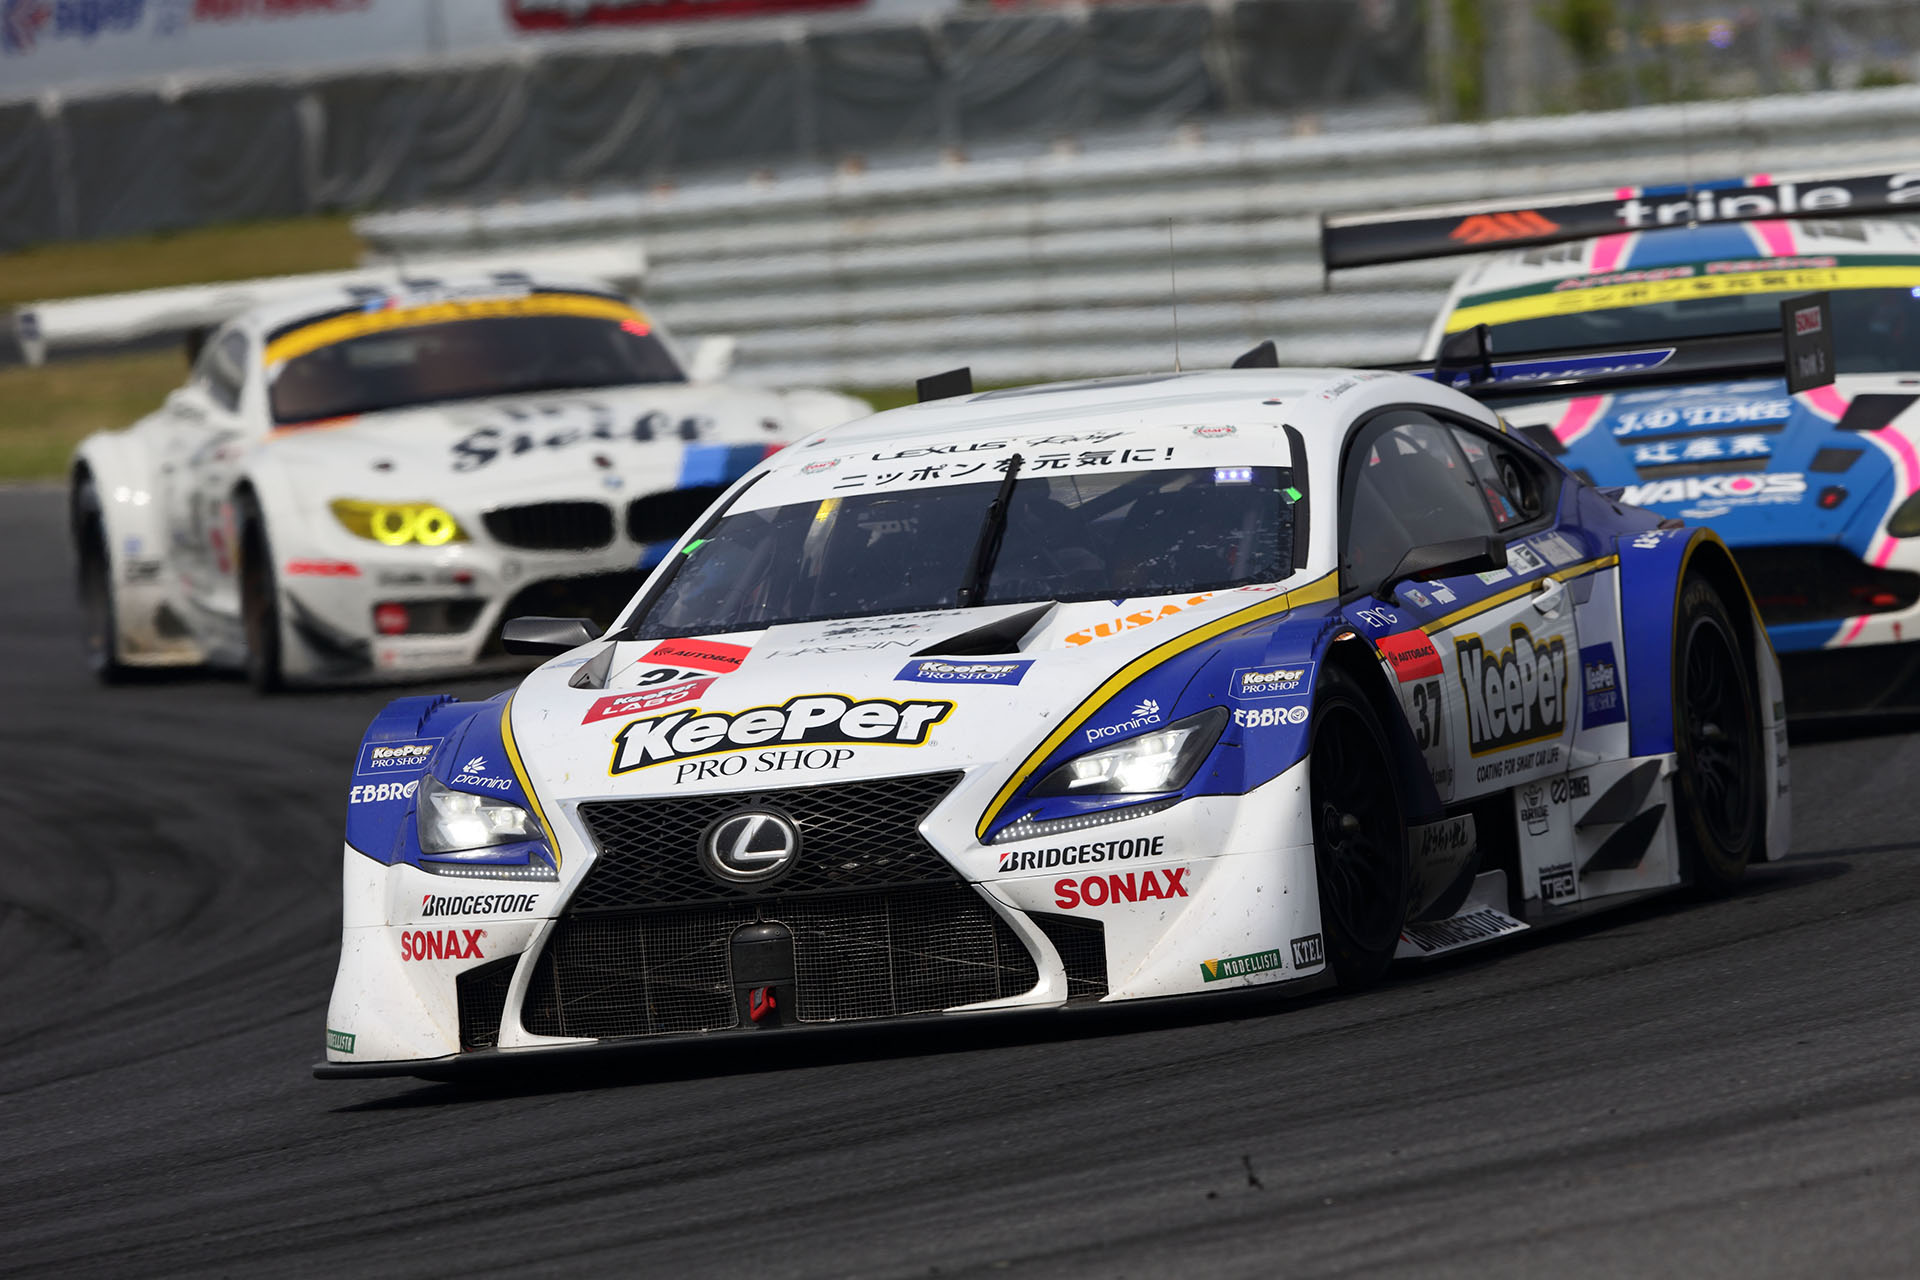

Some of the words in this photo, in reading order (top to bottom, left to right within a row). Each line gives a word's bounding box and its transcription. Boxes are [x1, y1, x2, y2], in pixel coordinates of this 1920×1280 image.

[1615, 182, 1851, 228] triple
[872, 440, 1008, 461] LEXUS
[917, 671, 955, 680] PRO
[956, 672, 1007, 681] SHOP
[918, 661, 1020, 674] KeePer
[1241, 669, 1305, 685] KeePer
[613, 682, 699, 706] KeePer
[1242, 683, 1266, 694] PRO
[1267, 681, 1299, 692] SHOP
[1456, 630, 1567, 751] KeePer
[601, 690, 690, 716] LABO
[1233, 705, 1310, 728] EBBRO
[1412, 680, 1443, 751] 37
[614, 695, 953, 774] KeePer
[1085, 713, 1161, 743] promina
[371, 758, 394, 768] PRO
[395, 756, 427, 766] SHOP
[372, 745, 433, 760] KeePer
[673, 755, 747, 785] PRO
[754, 749, 855, 773] SHOP
[451, 773, 513, 791] promina
[998, 835, 1164, 873] BRIDGESTONE
[1054, 867, 1189, 910] SONAX
[421, 893, 540, 917] BRIDGESTONE
[401, 928, 485, 962] SONAX
[1292, 938, 1323, 965] KTEL
[1223, 952, 1279, 976] MODELLISTA
